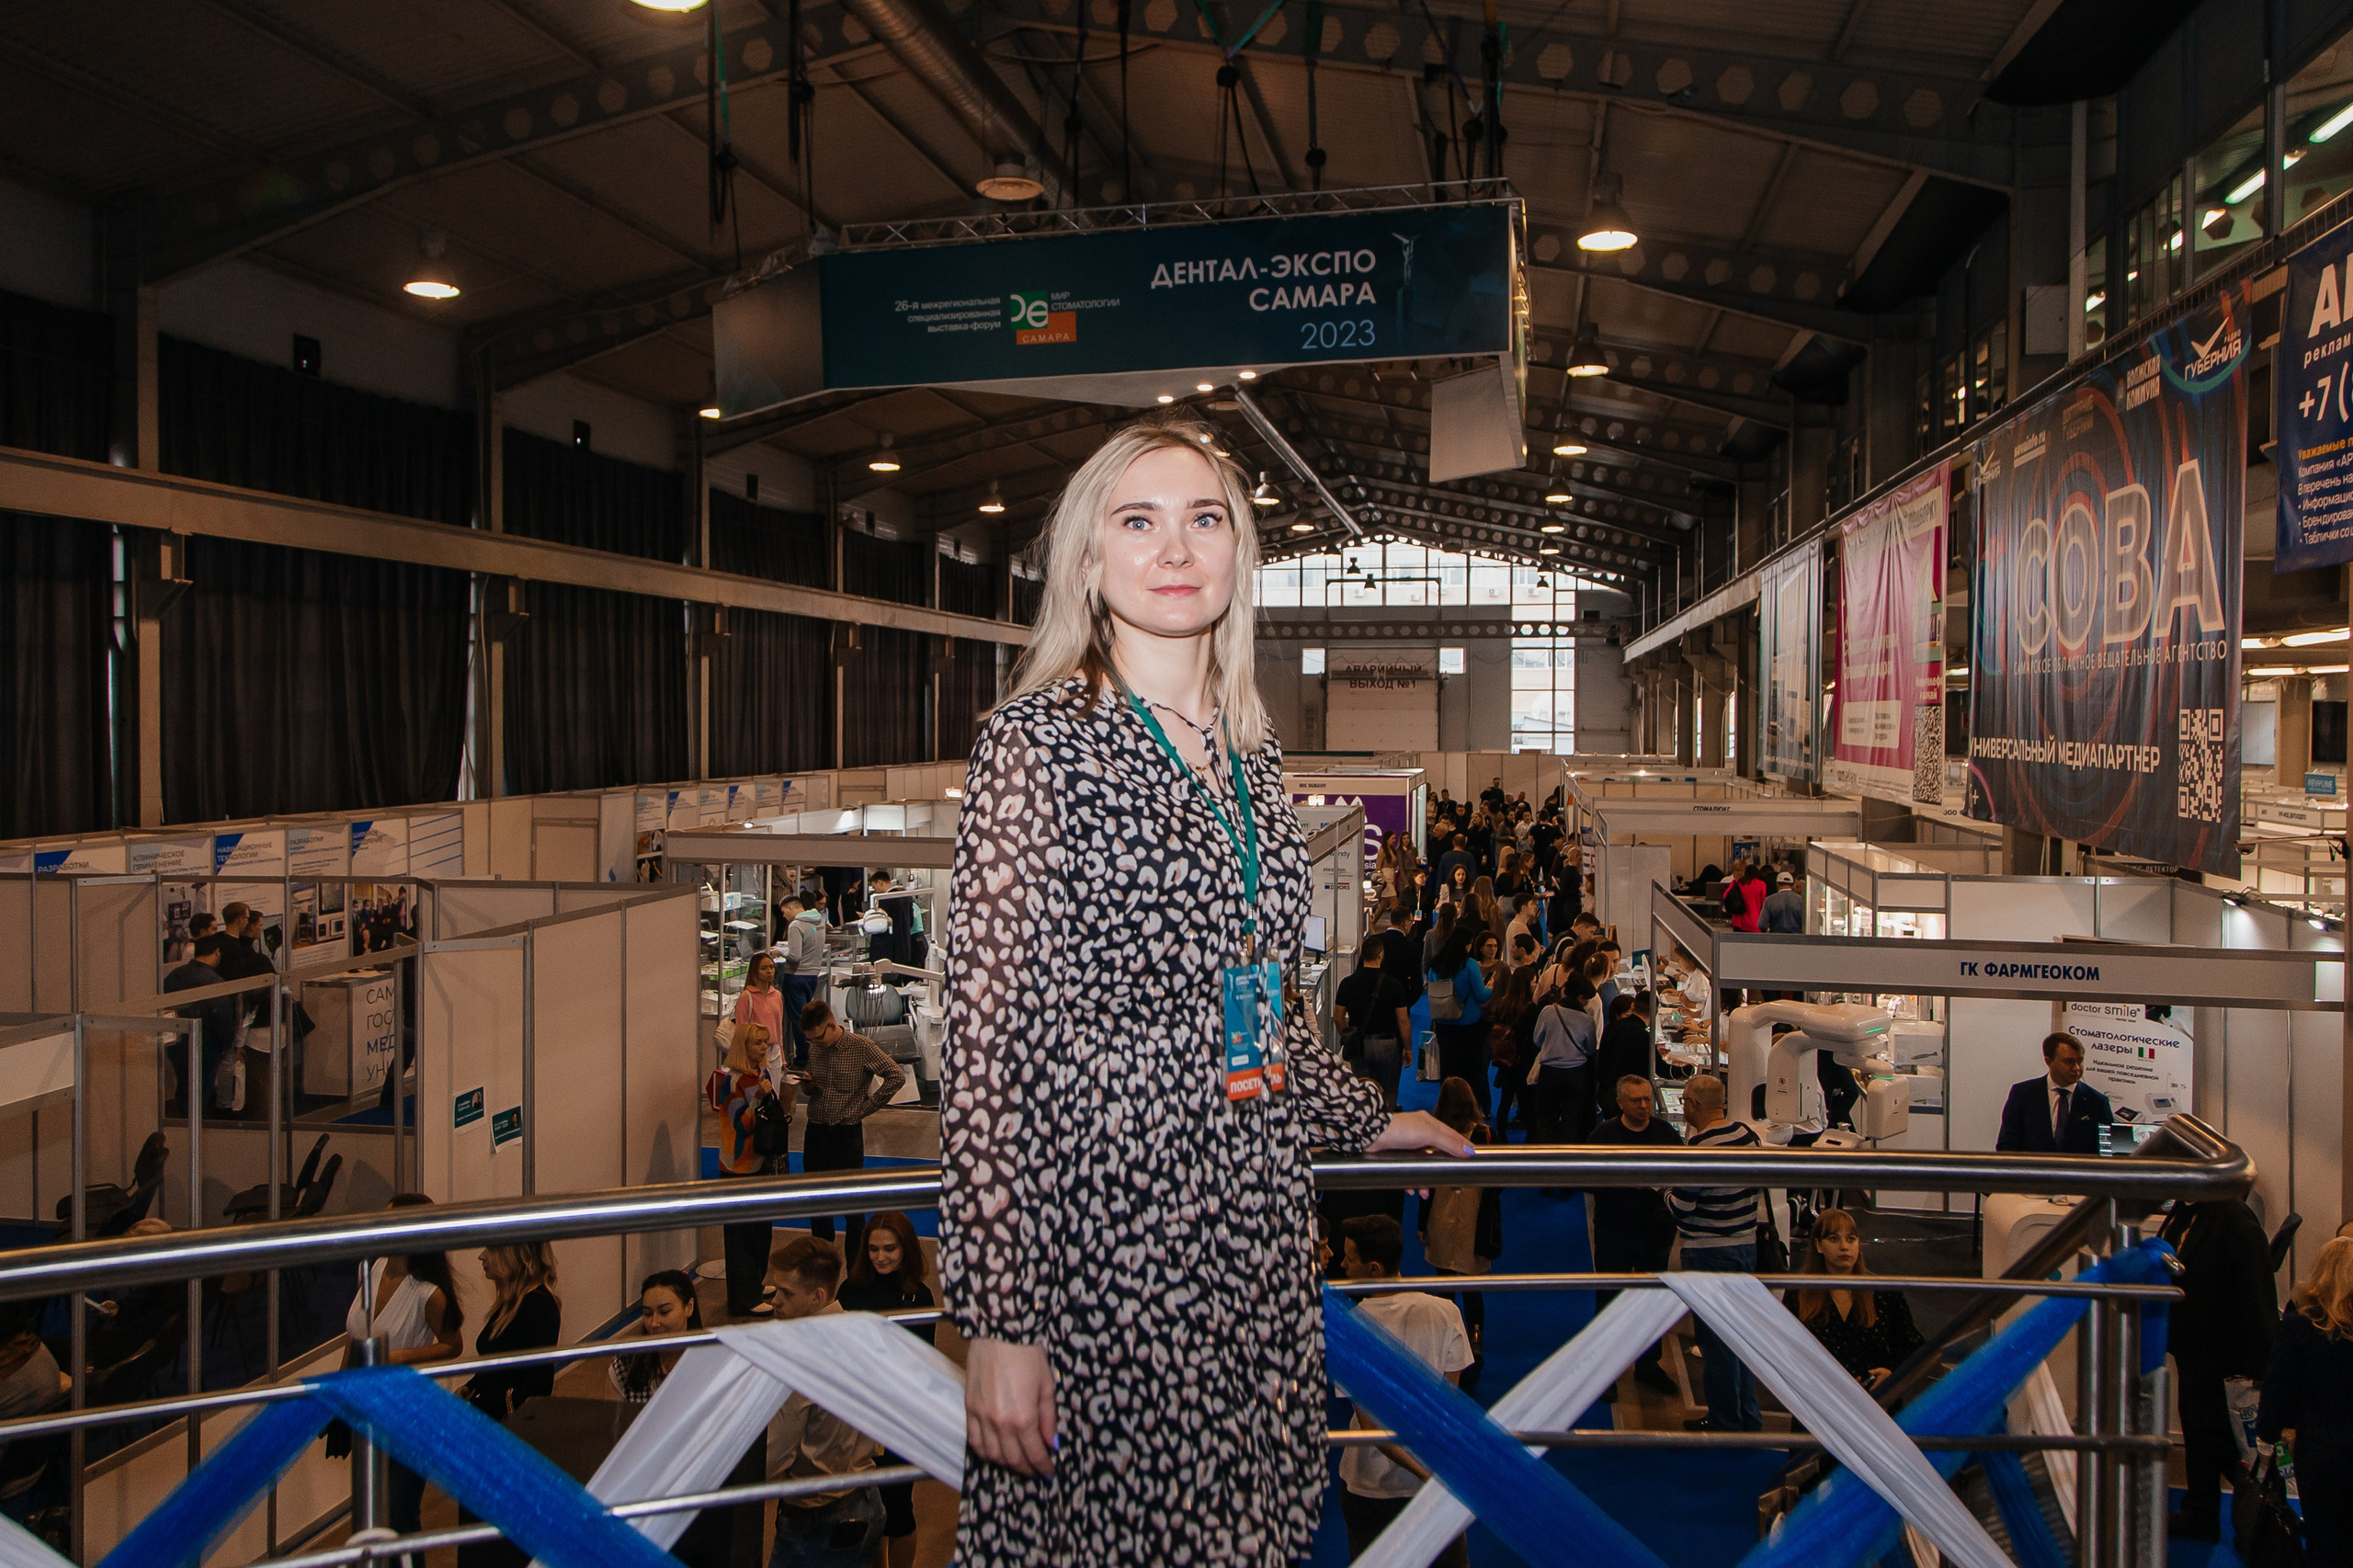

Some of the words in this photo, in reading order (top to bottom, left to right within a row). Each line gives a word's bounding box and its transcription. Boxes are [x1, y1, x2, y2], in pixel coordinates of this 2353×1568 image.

[1151, 249, 1376, 289] ДЕНТАЛ-ЭКСПО
[894, 300, 919, 312] 26-я
[921, 296, 1001, 310] межрегиональная
[1051, 291, 1070, 300] МИР
[1249, 281, 1376, 312] САМАРА
[2307, 252, 2353, 339] А
[1051, 298, 1120, 311] СТОМАТОЛОГИИ
[907, 309, 1001, 323] специализированная
[927, 321, 1001, 333] выставка-форум
[1301, 319, 1376, 349] 2023
[1022, 333, 1070, 344] САМАРА
[2185, 338, 2241, 381] ГУБЕРНИЯ
[2299, 375, 2332, 421] +7
[2298, 438, 2346, 460] Уважаемые
[2298, 460, 2335, 478] Компания
[2016, 459, 2224, 655] СОВА
[2097, 647, 2160, 670] ВЕЩАТЕЛЬНОЕ
[2164, 640, 2227, 663] АГЕНТСТВО
[1349, 679, 1393, 690] ВЫХОД
[1969, 735, 2055, 763] УНИВЕРСАЛЬНЫЙ
[2058, 741, 2160, 773] МЕДИАПАРТНЕР
[132, 850, 186, 862] КЛИНИЧЕСКОЕ
[217, 851, 258, 862] ТЕХНОЛОГИИ
[38, 861, 90, 873] РАЗРАБОТКИ
[132, 859, 182, 872] ПРИМЕНЕНИЕ
[1961, 961, 1979, 976] ГК
[1984, 962, 2100, 981] ФАРМГЕОКОМ
[2071, 1003, 2101, 1014] doctor
[2068, 1026, 2180, 1048] Стоматологические
[2091, 1043, 2132, 1054] лазеры
